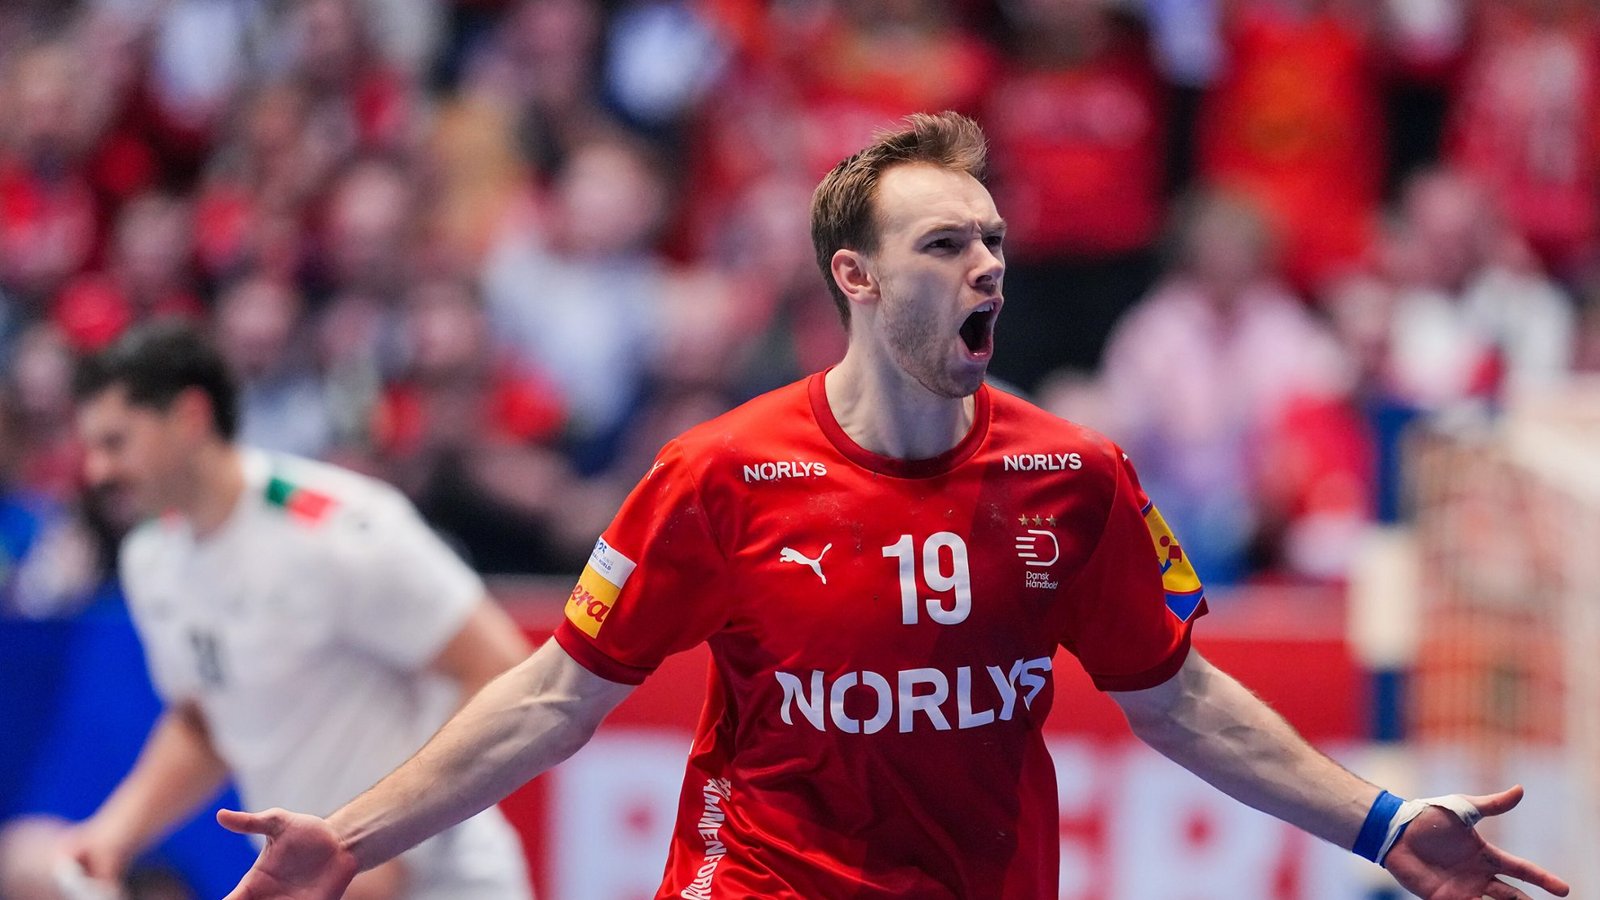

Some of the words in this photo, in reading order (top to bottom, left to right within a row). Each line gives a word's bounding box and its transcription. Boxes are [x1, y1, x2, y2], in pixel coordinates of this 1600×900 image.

[743, 461, 827, 482] NORLYS
[1002, 452, 1082, 471] NORLYS
[881, 531, 972, 625] 19
[1026, 571, 1050, 581] Dansk
[774, 656, 1053, 735] NORLYS
